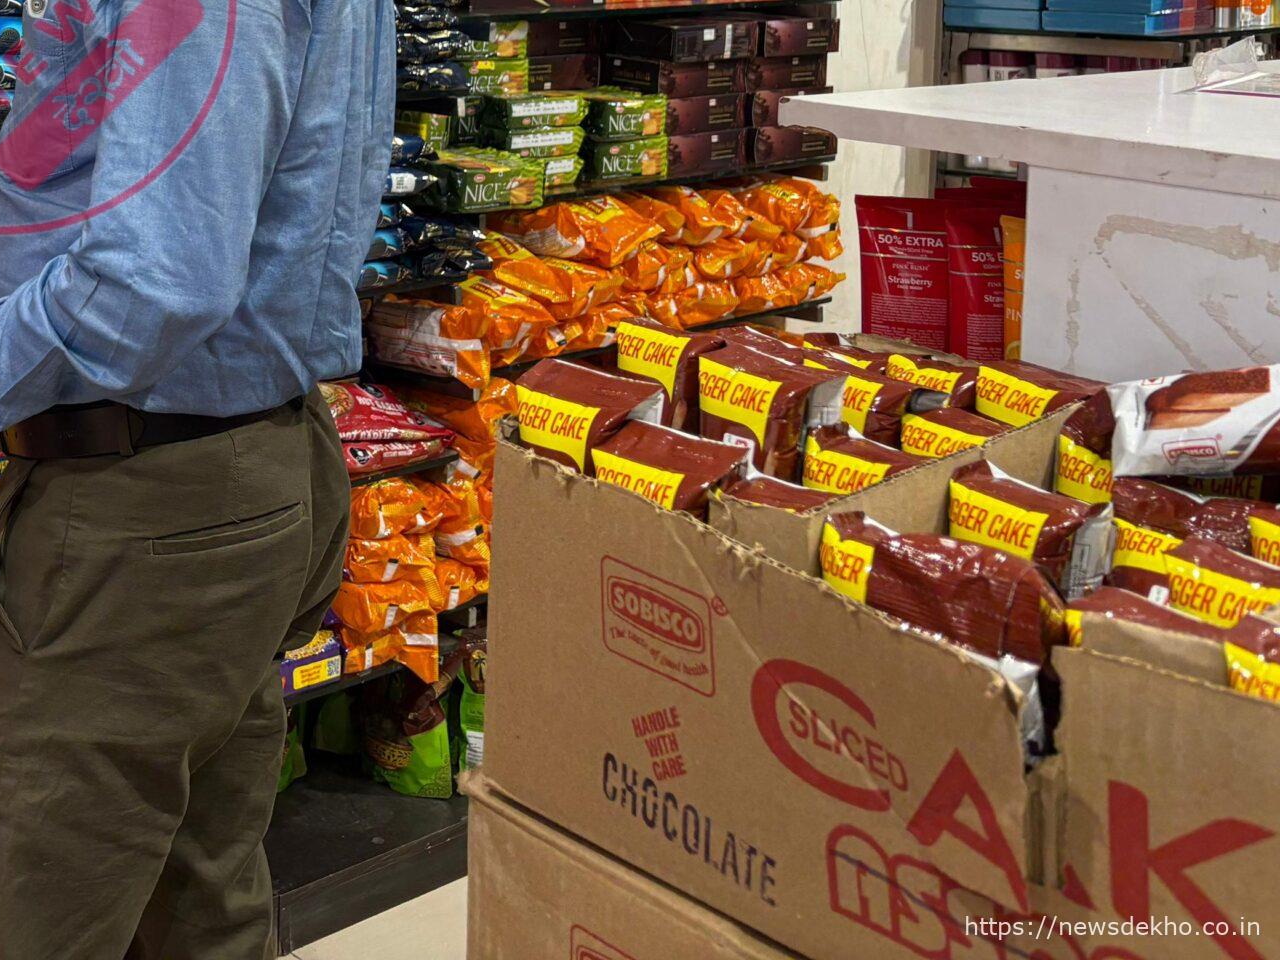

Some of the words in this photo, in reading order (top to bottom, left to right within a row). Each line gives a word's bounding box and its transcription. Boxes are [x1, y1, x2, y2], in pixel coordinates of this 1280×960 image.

[878, 234, 902, 245] 50%
[906, 236, 944, 248] EXTRA
[888, 275, 932, 288] Strawberry
[643, 341, 677, 367] CAKE
[730, 381, 770, 413] CAKE
[989, 513, 1037, 549] CAKE
[611, 587, 697, 642] SOBISCO
[631, 706, 680, 737] HANDLE
[644, 732, 679, 758] WITH
[789, 698, 909, 791] SLICED
[652, 755, 686, 781] CARE
[602, 752, 777, 907] CHOCOLATE
